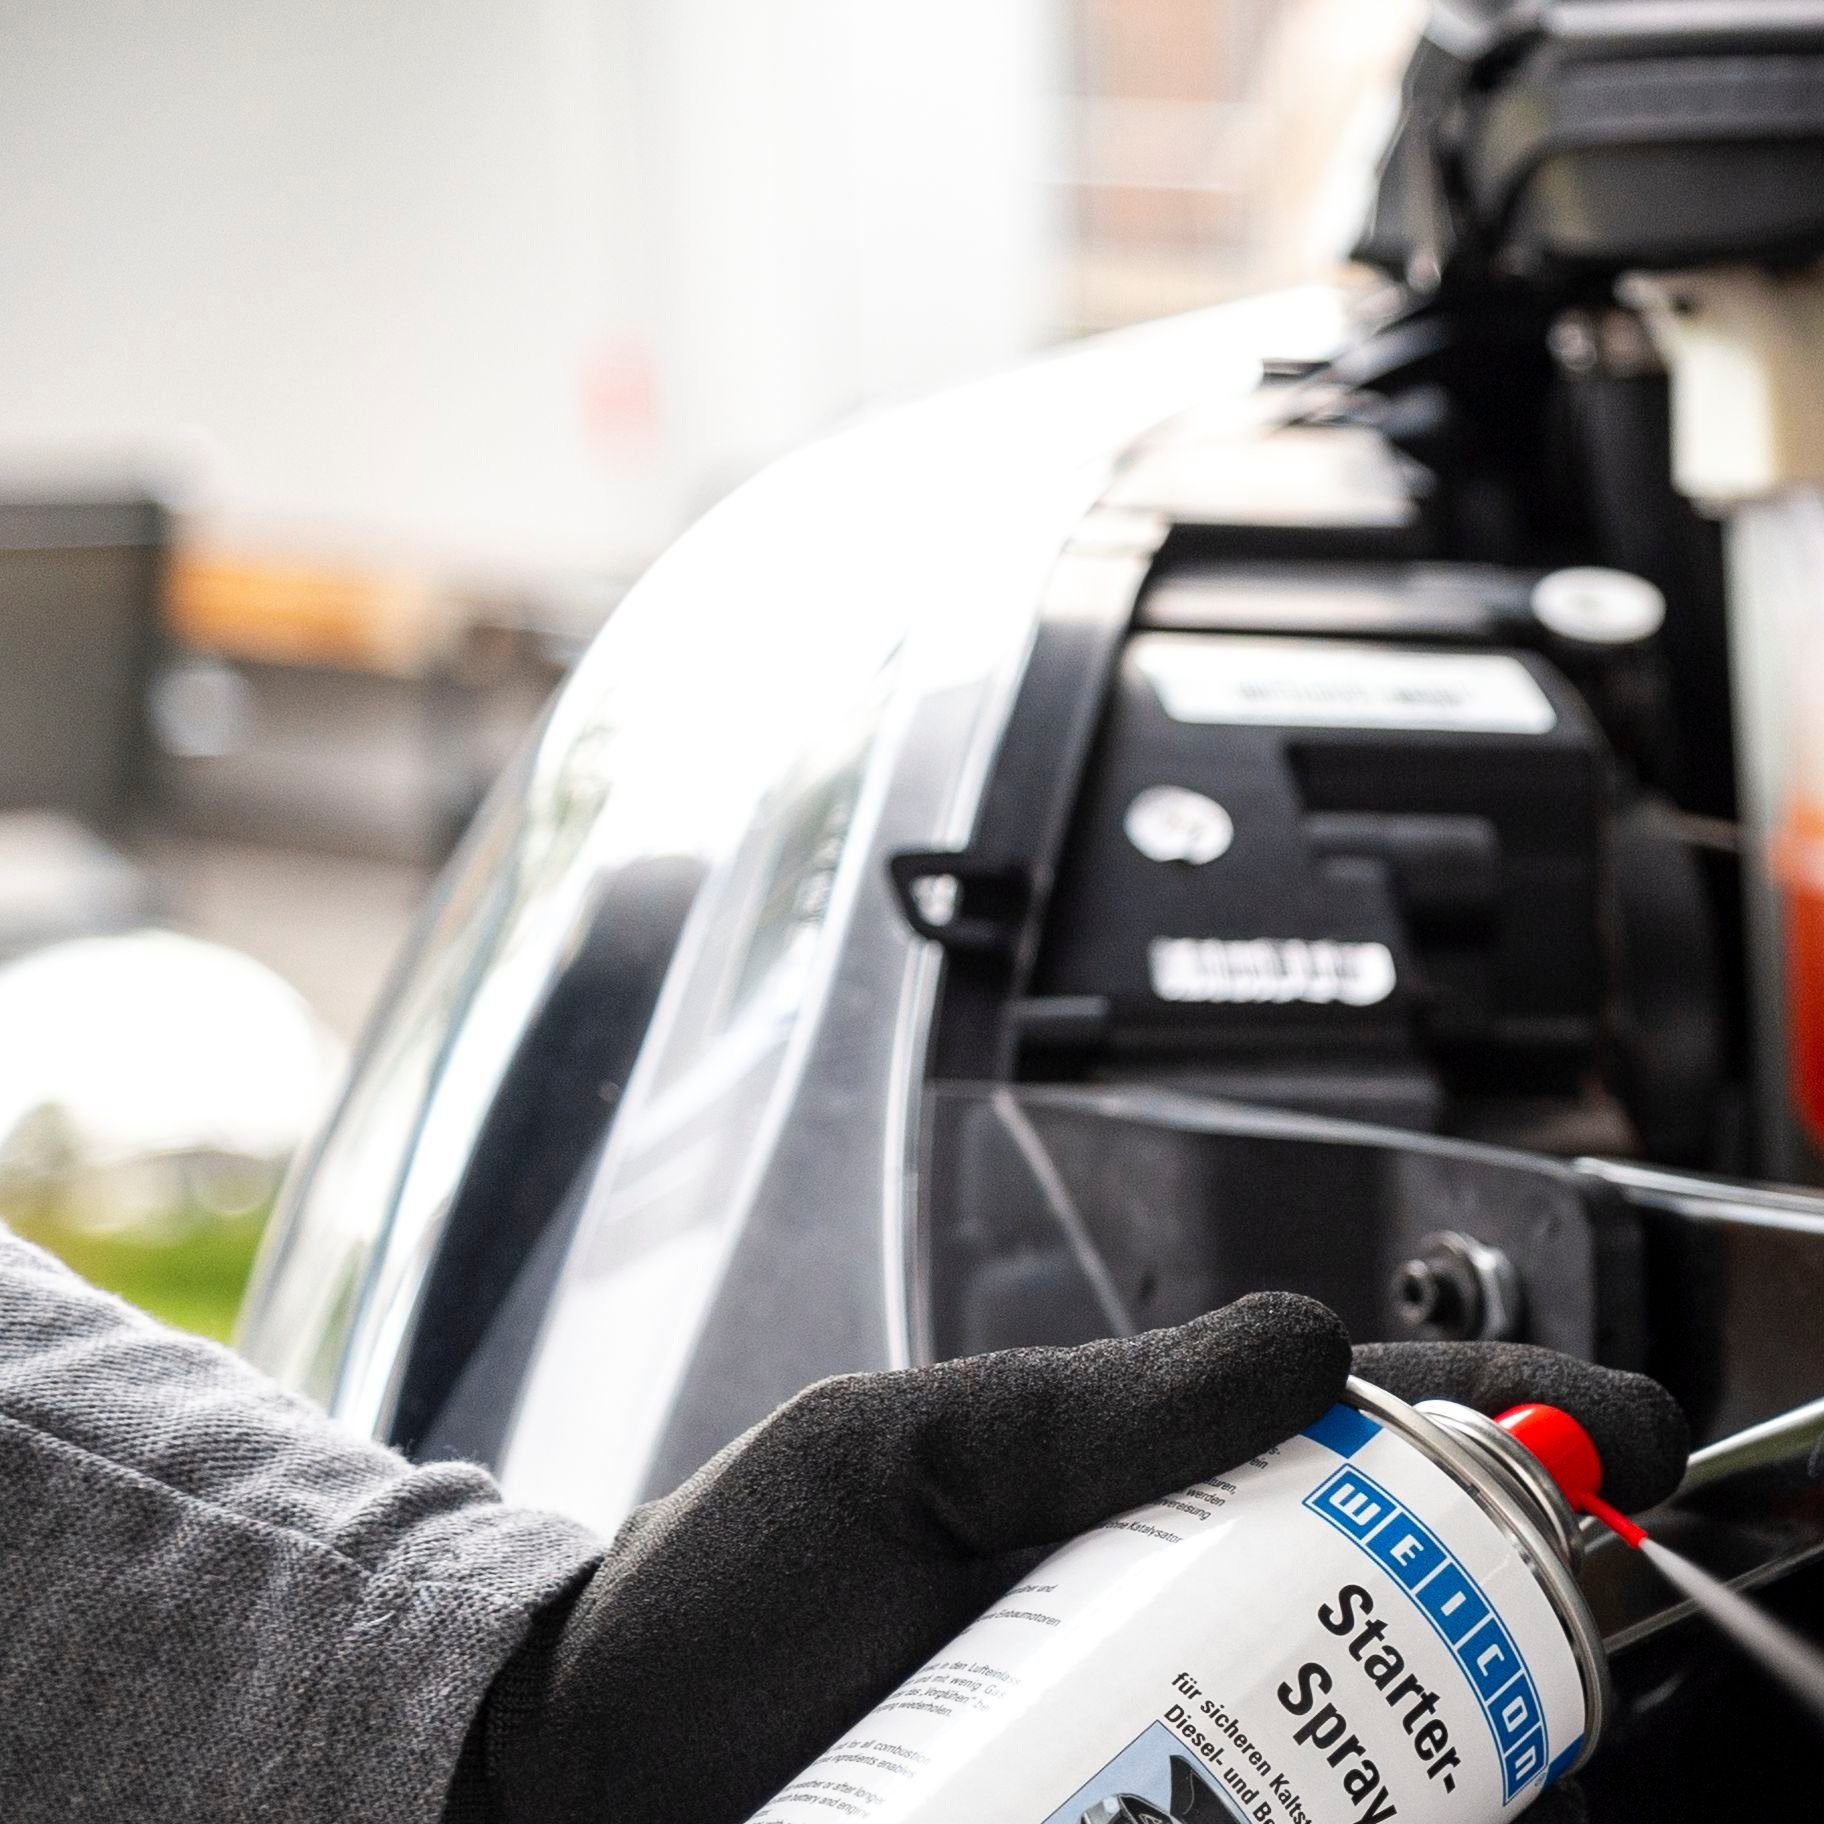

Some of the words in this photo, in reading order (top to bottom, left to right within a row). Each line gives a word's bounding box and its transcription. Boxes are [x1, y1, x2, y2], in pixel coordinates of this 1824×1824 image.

[1126, 1520, 1184, 1544] Katalysator
[1185, 1486, 1226, 1507] werden
[1326, 1481, 1538, 1783] WEICON
[1171, 1671, 1203, 1703] für
[1199, 1699, 1272, 1778] sicheren
[1316, 1583, 1463, 1795] Starter-
[818, 1796, 842, 1808] and
[1163, 1703, 1224, 1767] Diesel-
[1222, 1766, 1258, 1806] und
